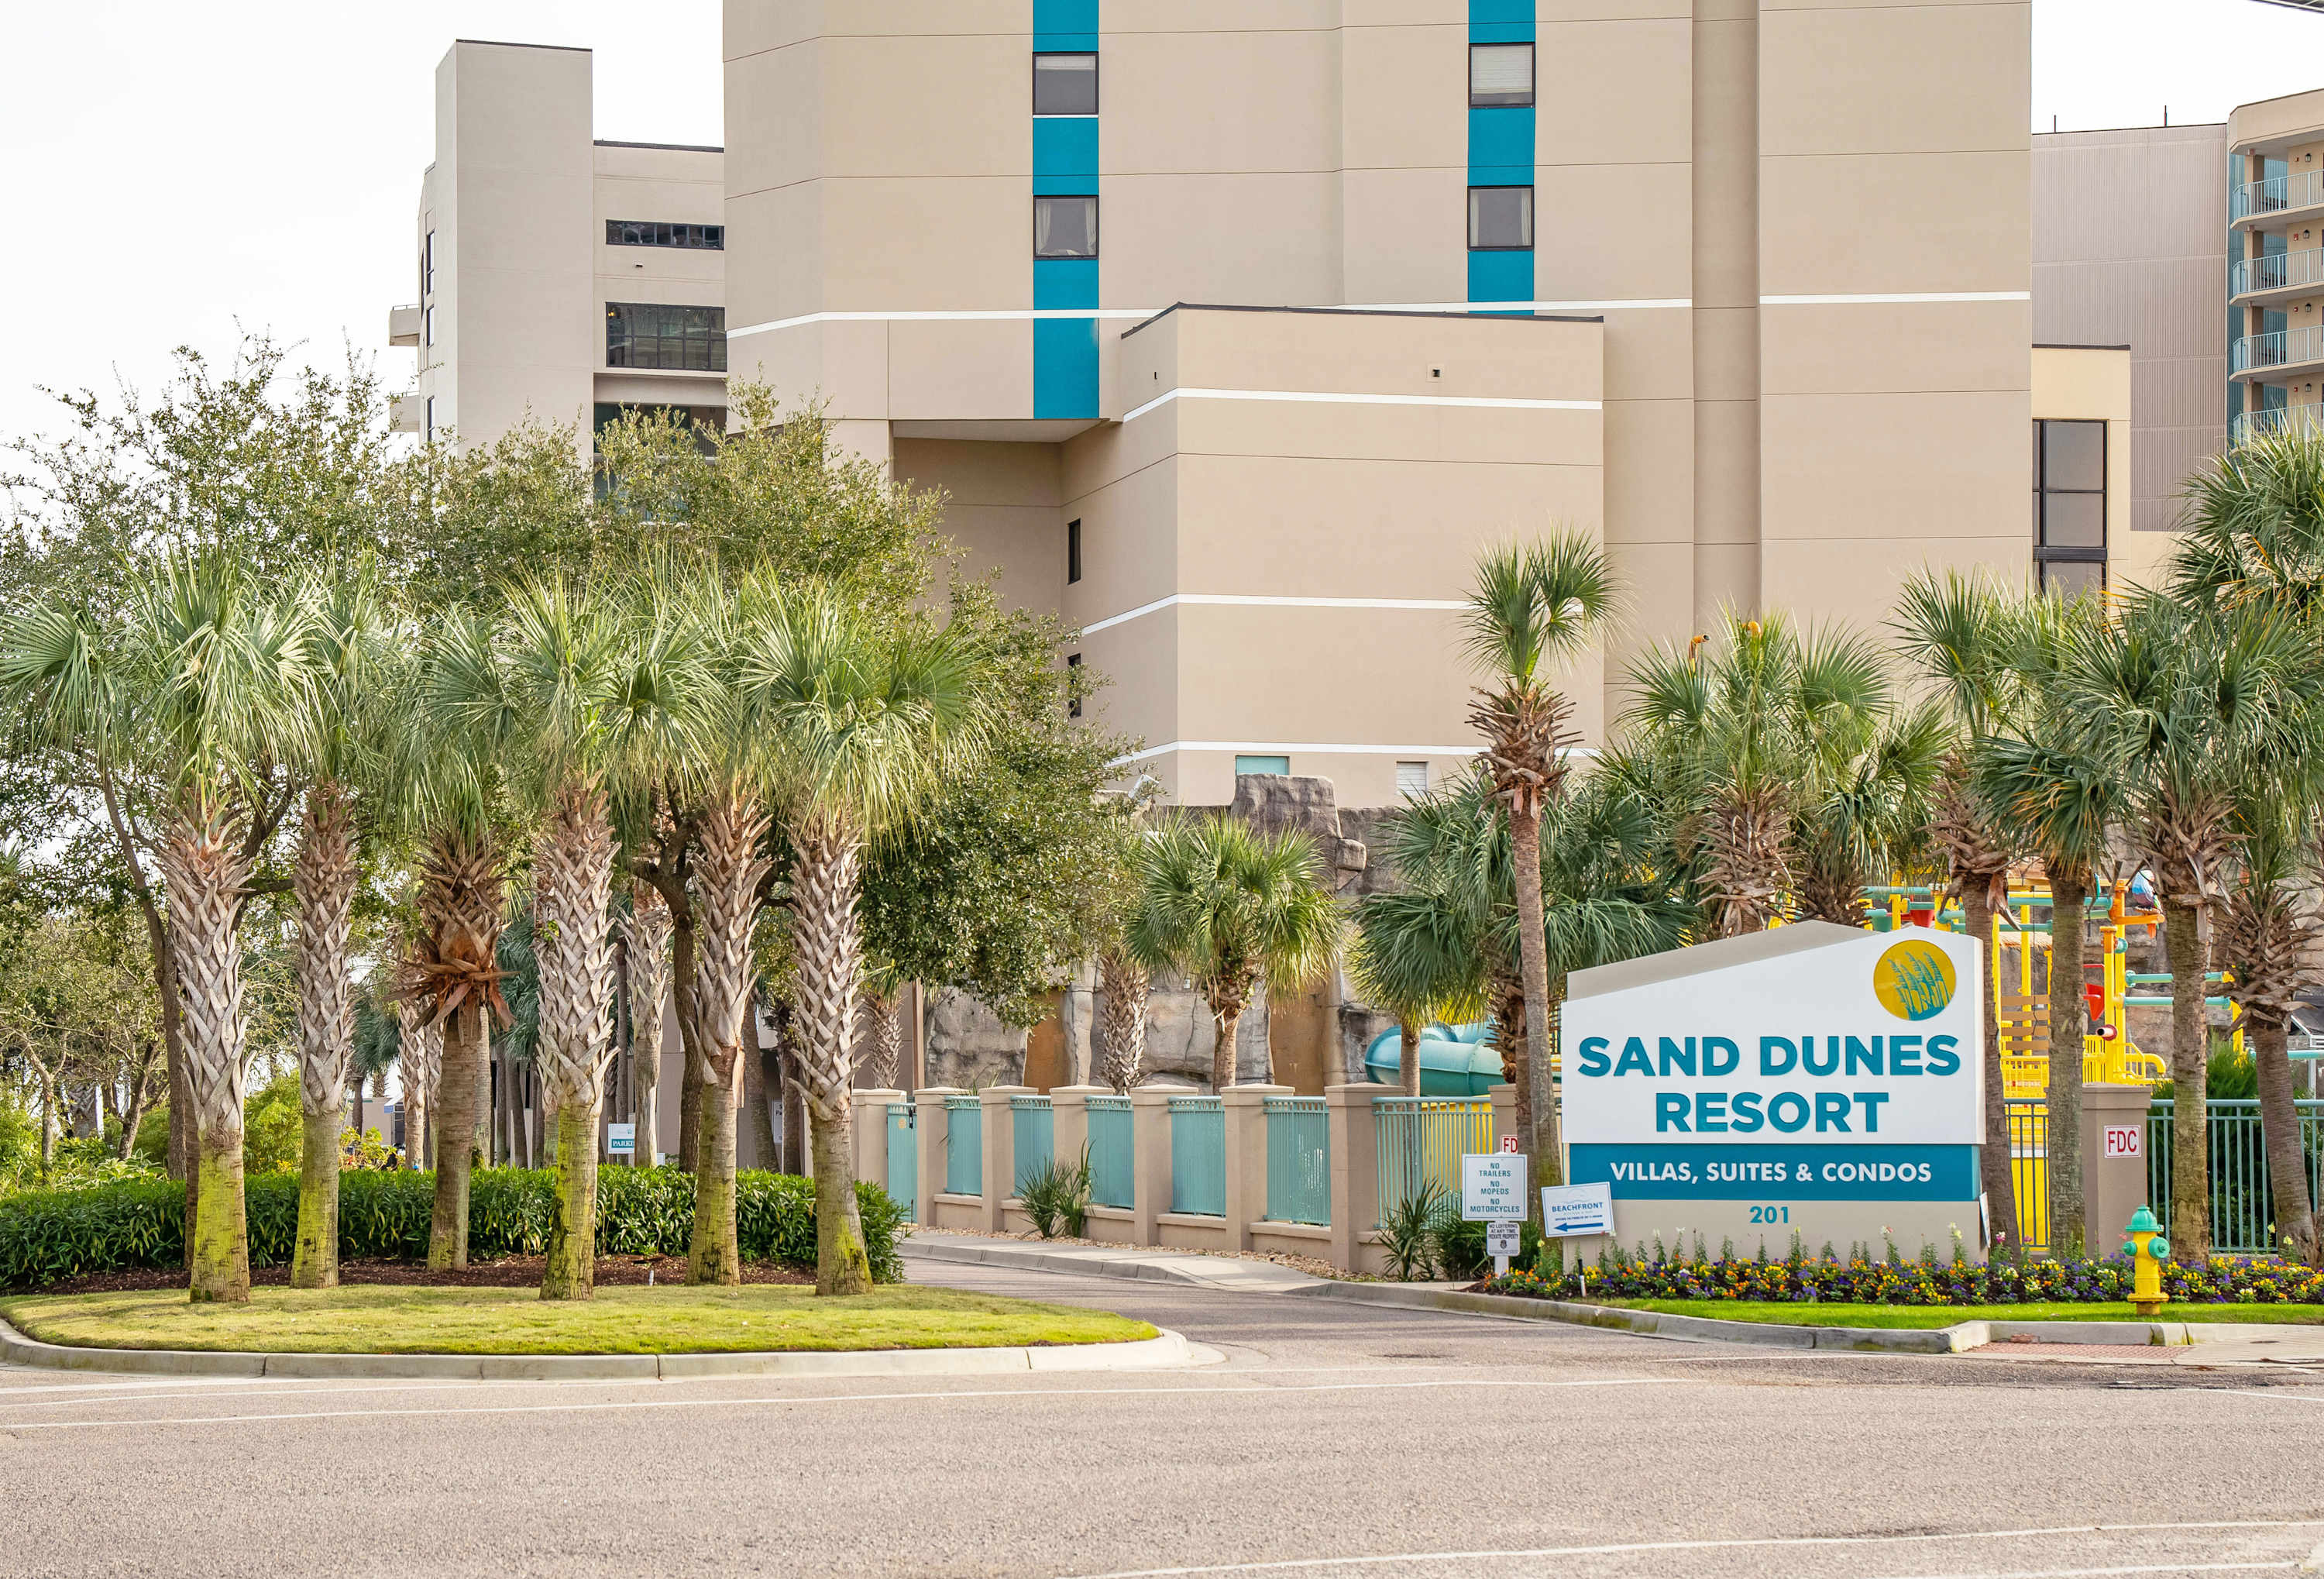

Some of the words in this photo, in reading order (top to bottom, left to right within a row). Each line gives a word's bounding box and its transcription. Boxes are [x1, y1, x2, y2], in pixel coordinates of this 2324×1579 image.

[1577, 1035, 1741, 1078] SAND
[1759, 1034, 1961, 1077] DUNES
[1655, 1091, 1890, 1134] RESORT
[1504, 1137, 1518, 1153] FD
[2107, 1130, 2137, 1153] FDC
[1610, 1161, 1699, 1185] VILLAS,
[1706, 1162, 1787, 1182] SUITES
[1796, 1162, 1813, 1182] &
[1822, 1161, 1932, 1182] CONDOS
[1552, 1202, 1604, 1213] BEACHFRONT
[1749, 1206, 1789, 1224] 201
